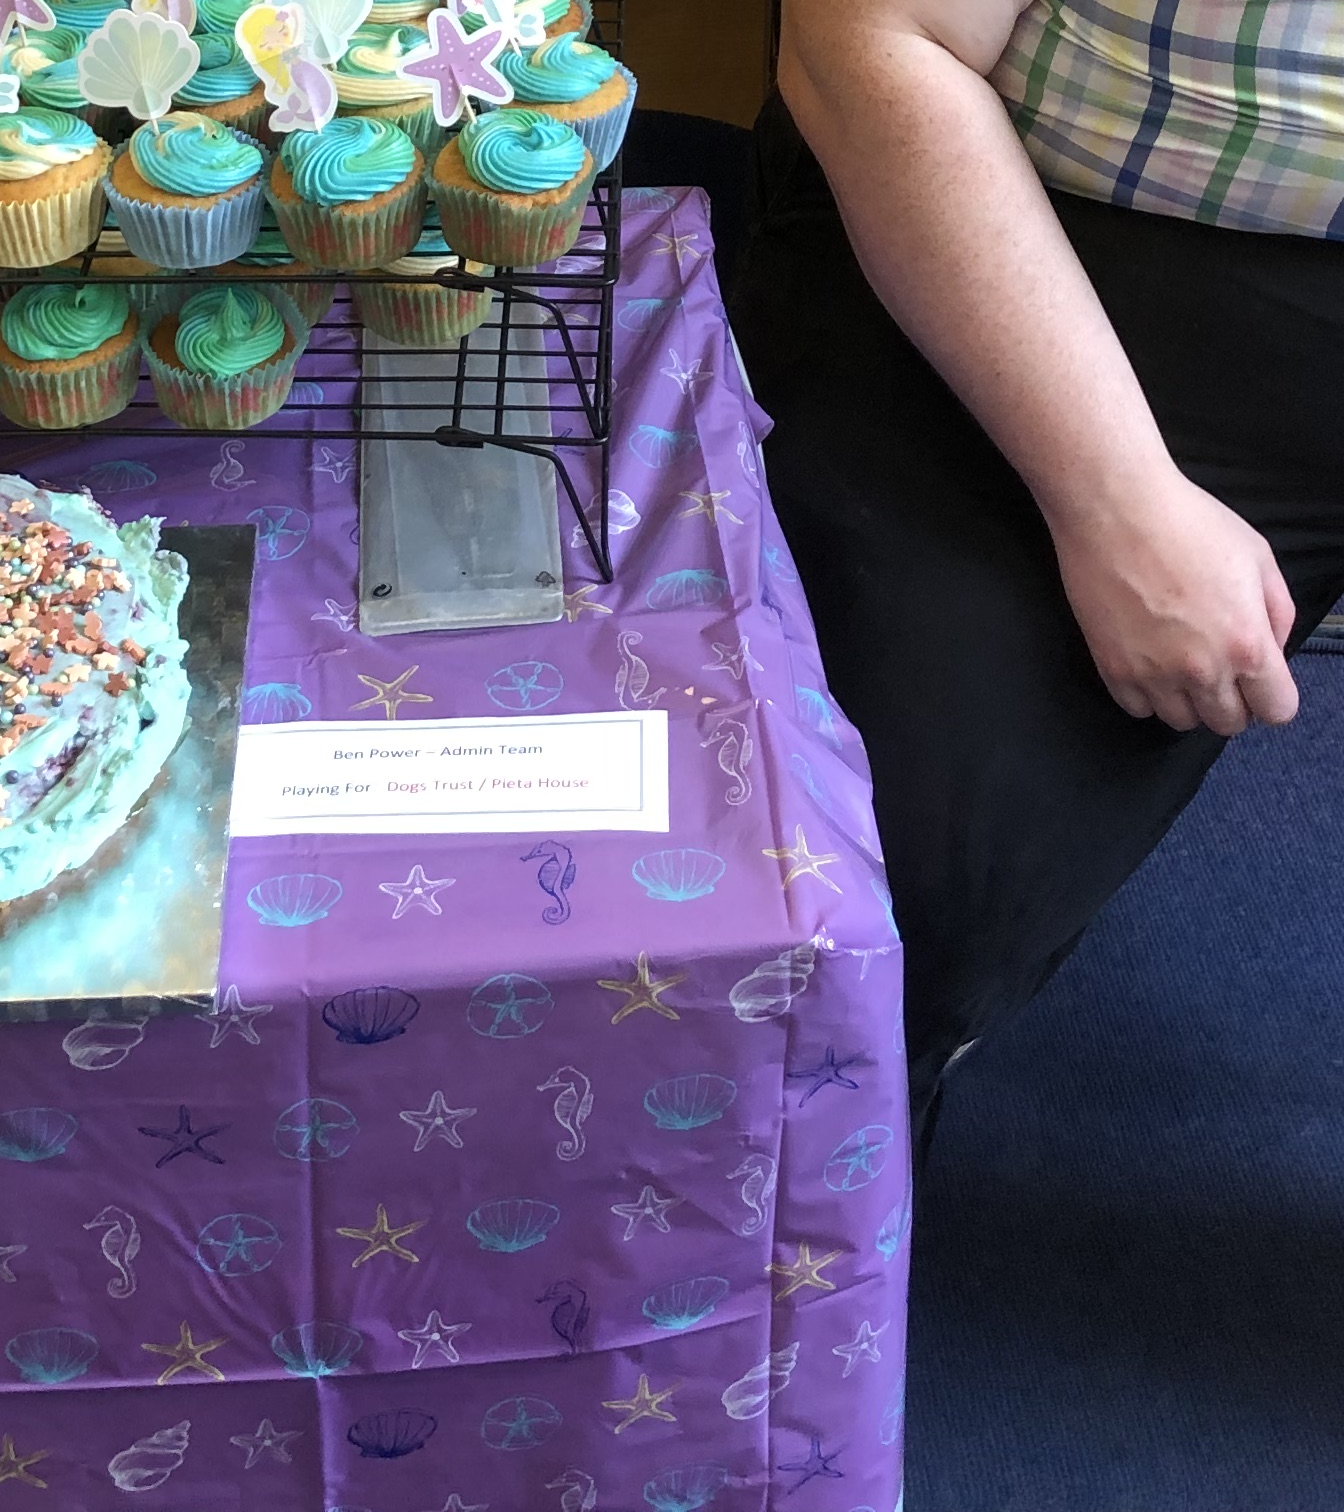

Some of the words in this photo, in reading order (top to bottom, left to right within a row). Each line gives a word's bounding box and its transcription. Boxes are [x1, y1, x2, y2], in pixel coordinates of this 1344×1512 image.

[333, 749, 364, 760] Ben
[369, 748, 421, 759] Power
[440, 745, 493, 756] Admin
[498, 744, 543, 755] Team
[281, 784, 340, 797] Playing
[387, 781, 427, 794] Dogs
[433, 779, 473, 790] Trust
[478, 777, 487, 792] /
[492, 778, 532, 789] Pieta
[538, 777, 589, 788] House
